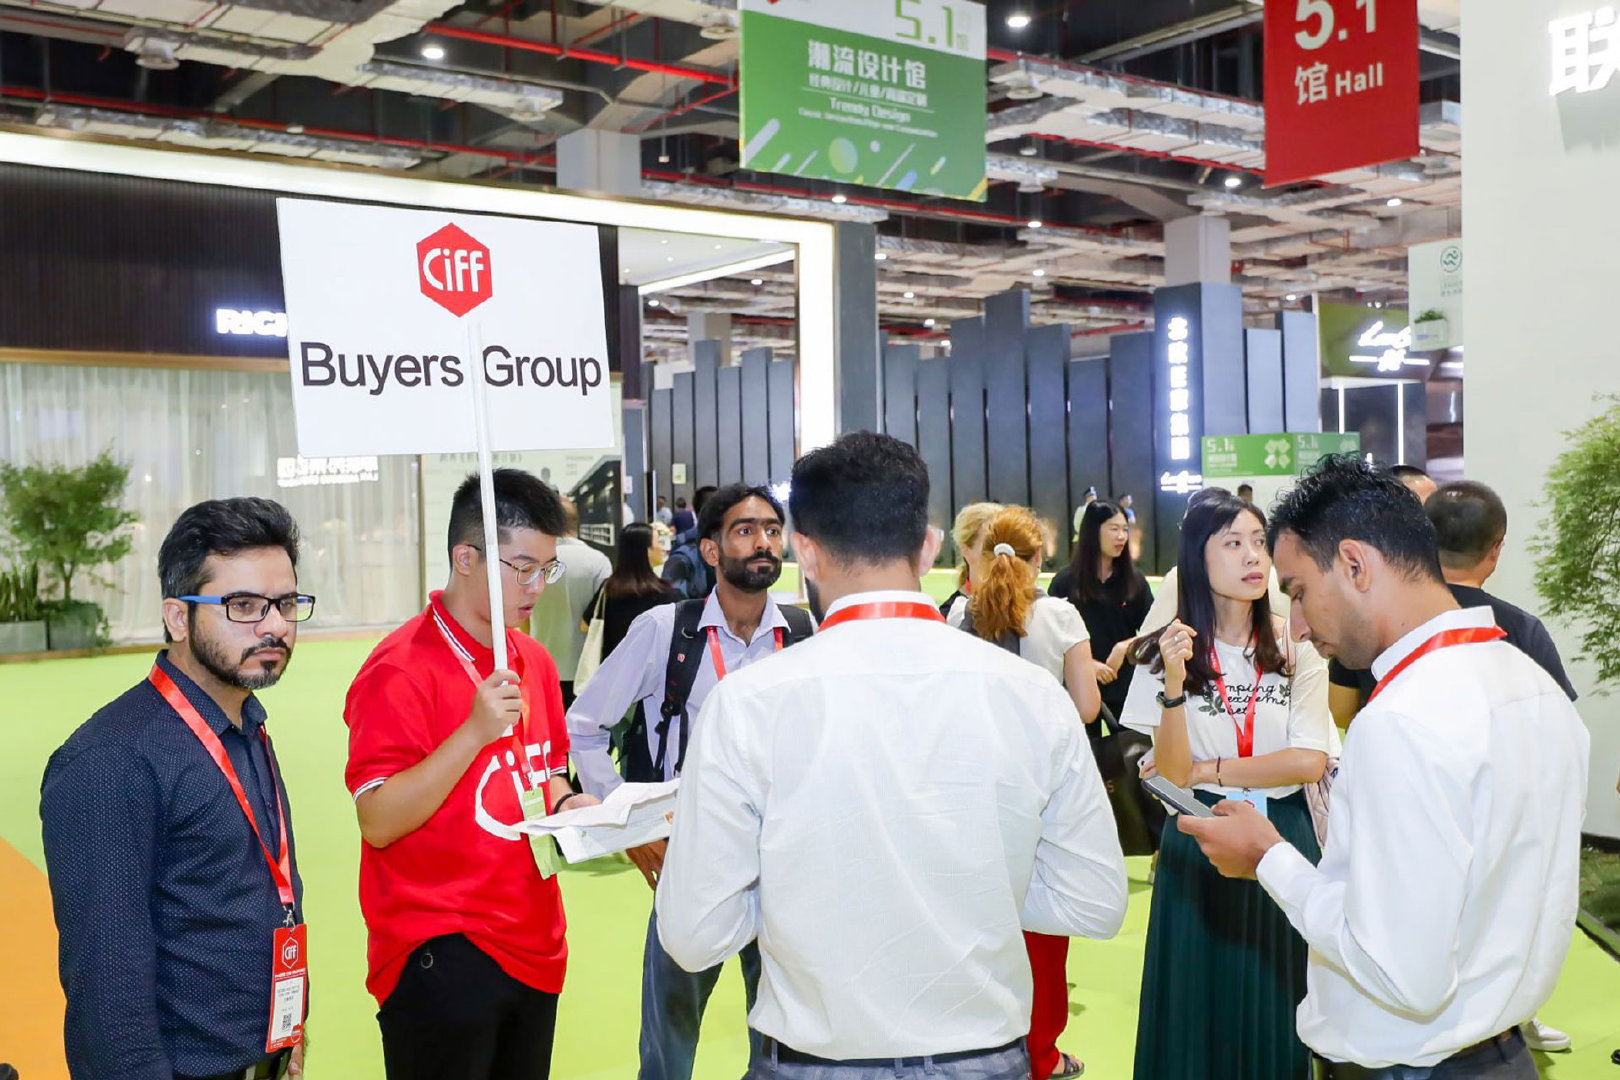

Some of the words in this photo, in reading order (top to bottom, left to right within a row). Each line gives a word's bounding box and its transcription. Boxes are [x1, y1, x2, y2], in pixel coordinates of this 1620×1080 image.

[896, 0, 953, 47] 5.1
[1295, 0, 1376, 50] 5.1
[1295, 61, 1328, 106] 馆
[1335, 62, 1383, 97] Hall
[300, 342, 464, 396] Buyers
[483, 345, 602, 396] Group
